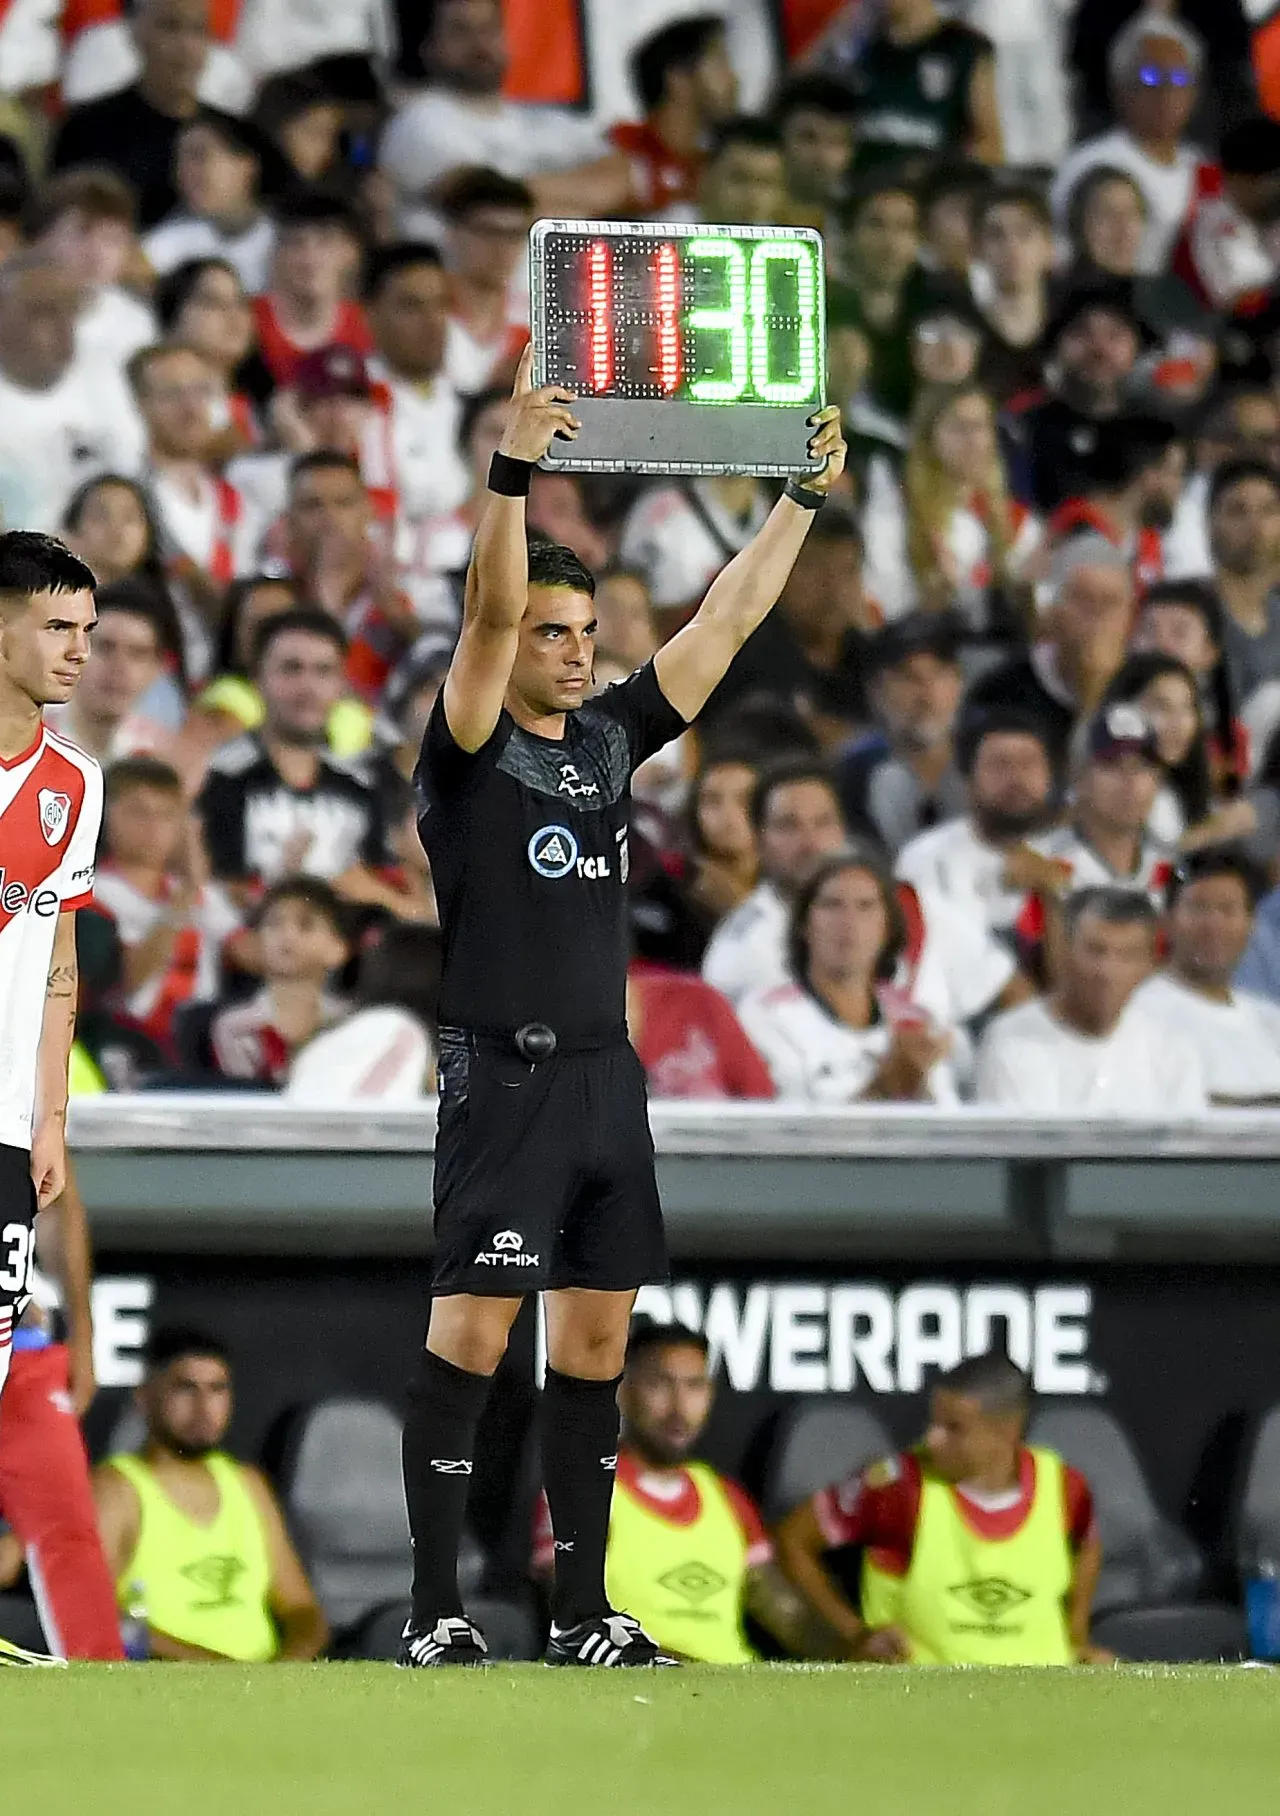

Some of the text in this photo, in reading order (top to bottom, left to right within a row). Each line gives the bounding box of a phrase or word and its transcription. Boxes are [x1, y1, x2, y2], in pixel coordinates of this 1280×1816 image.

[589, 237, 816, 402] 11 30
[474, 1252, 539, 1267] ATHIX
